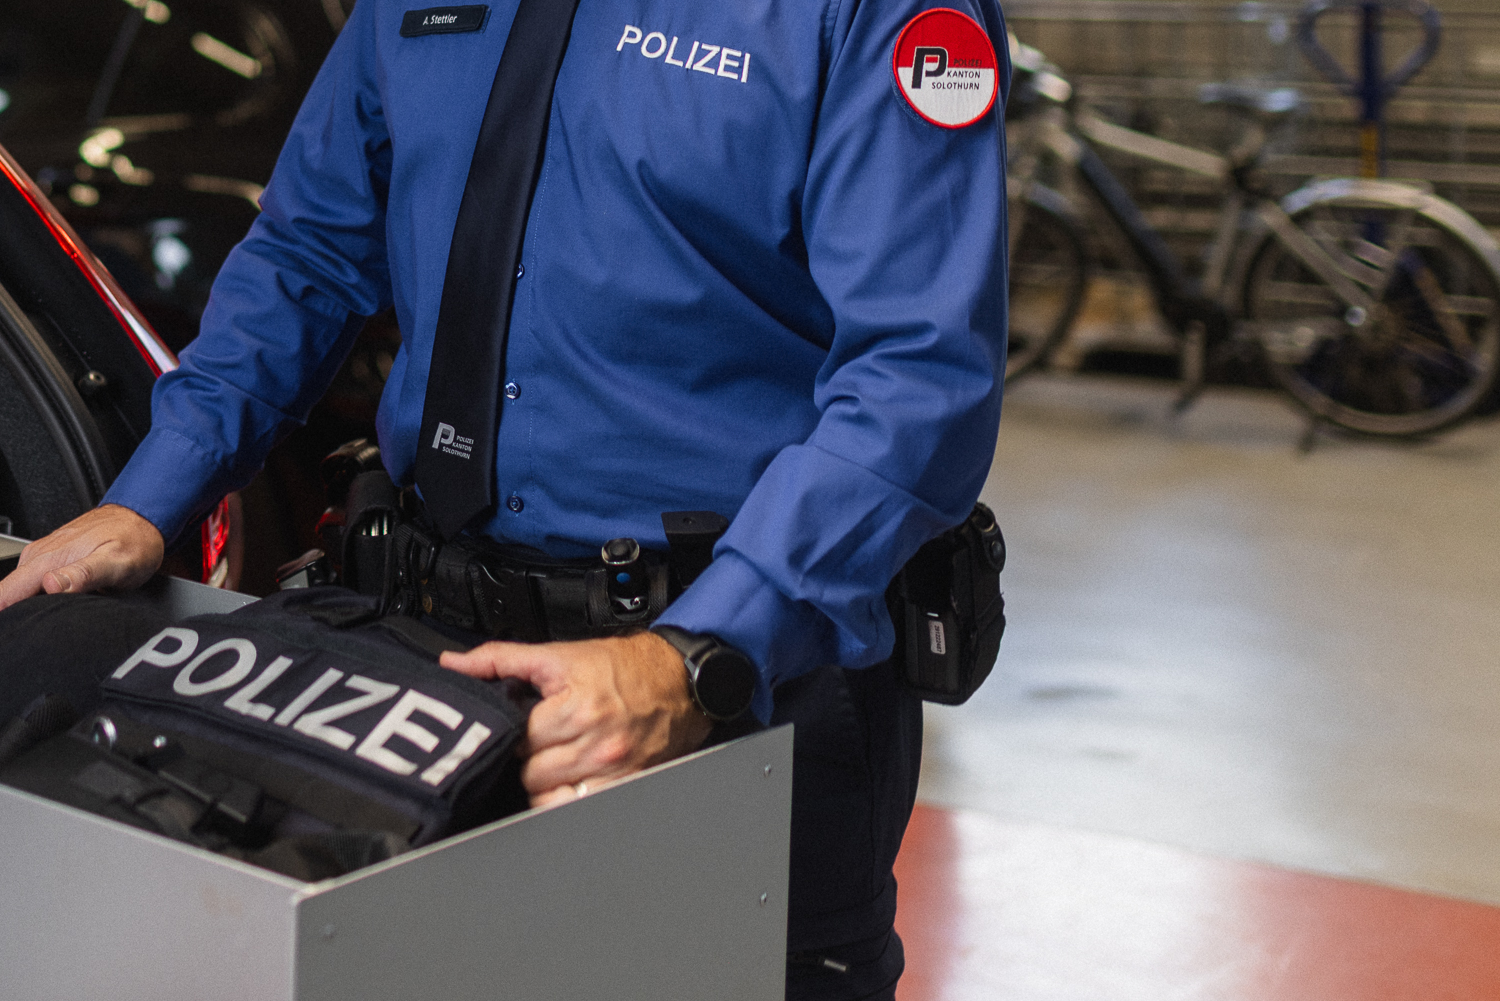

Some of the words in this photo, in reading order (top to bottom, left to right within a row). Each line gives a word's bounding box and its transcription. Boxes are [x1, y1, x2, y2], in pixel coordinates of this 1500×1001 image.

[430, 13, 458, 25] Stettler
[616, 24, 751, 83] POLIZEI
[911, 46, 948, 89] P
[953, 58, 982, 67] POLIZEI
[947, 70, 980, 79] KANTON
[932, 82, 980, 90] SOLOTHURN
[456, 435, 474, 445] POLIZEI
[452, 442, 472, 452] KANTON
[442, 446, 470, 460] SOLOTHURN
[111, 627, 492, 787] POLIZEI
